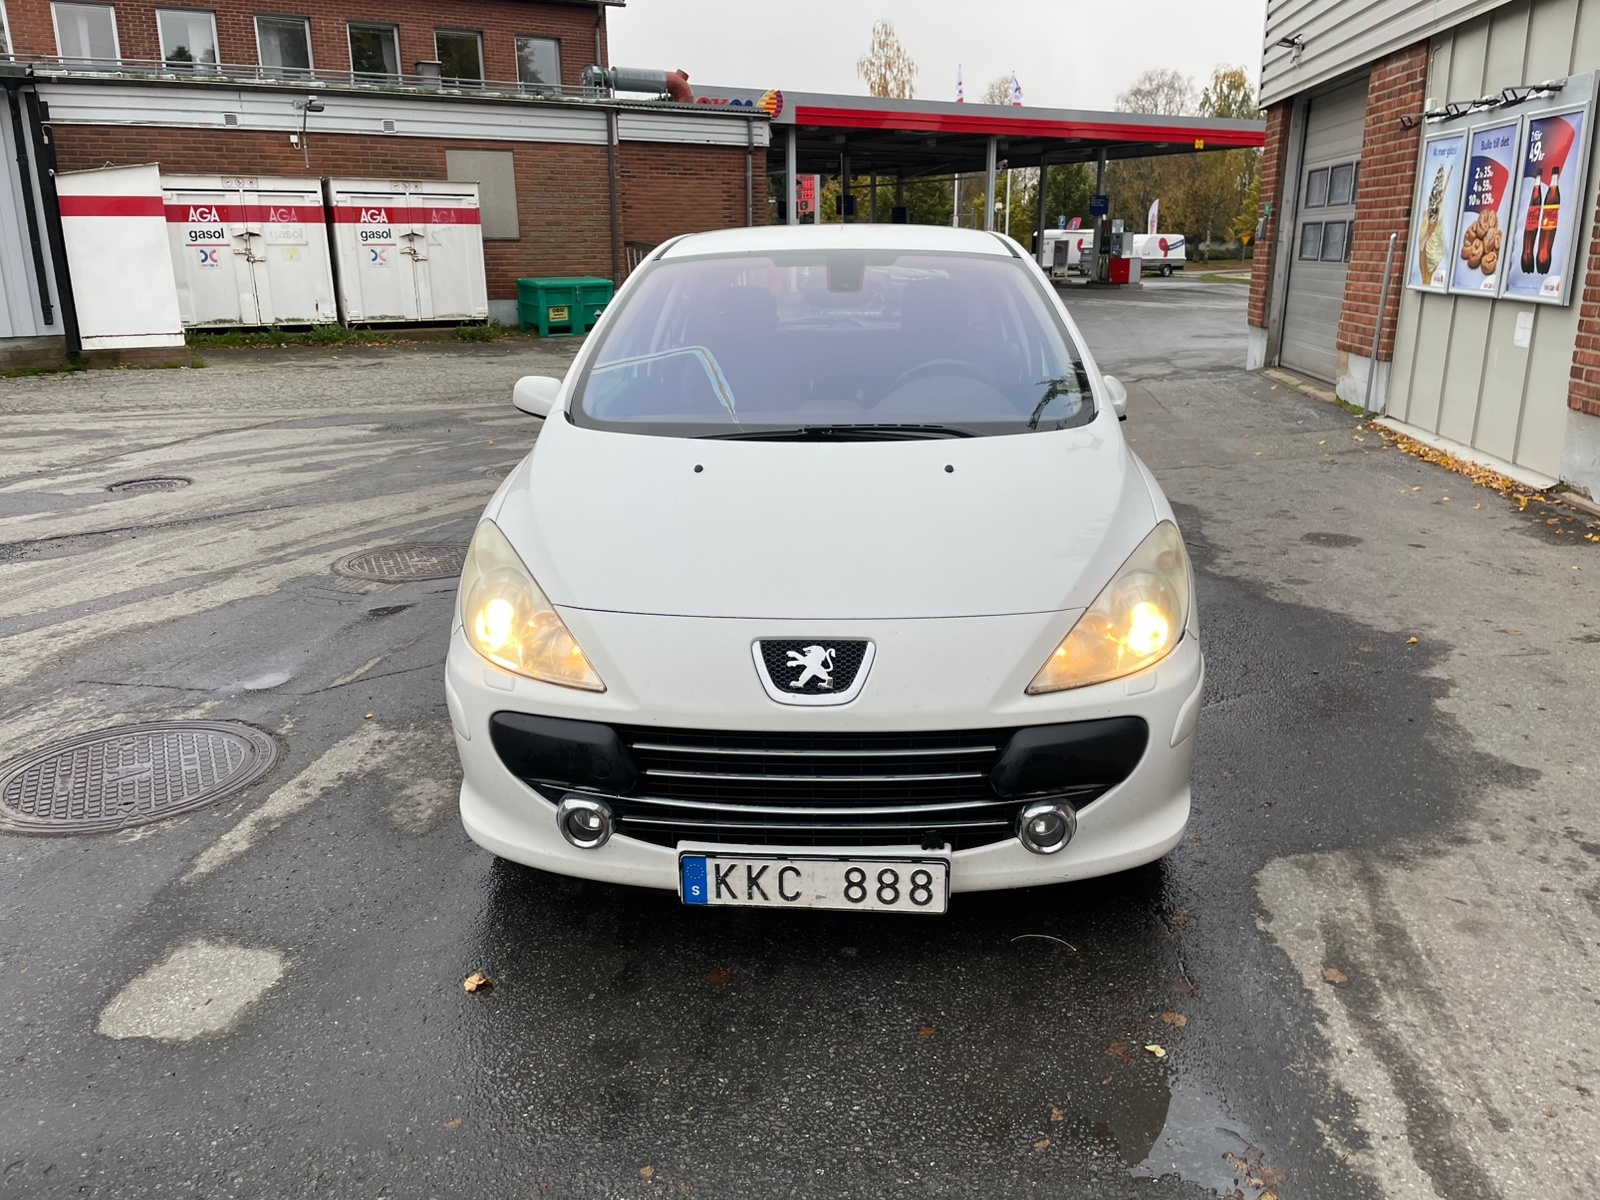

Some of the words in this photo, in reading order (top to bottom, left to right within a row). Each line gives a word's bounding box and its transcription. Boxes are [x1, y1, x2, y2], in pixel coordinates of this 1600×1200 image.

[1500, 136, 1509, 147] det
[1475, 167, 1480, 179] 2
[1468, 194, 1476, 206] 10
[188, 206, 220, 222] AGA
[269, 206, 297, 222] AGA
[360, 208, 388, 223] AGA
[431, 209, 456, 223] AGA
[189, 228, 224, 242] gasol
[270, 228, 303, 240] gasol
[360, 228, 391, 241] gasol
[691, 886, 700, 896] S
[714, 863, 802, 901] KKC
[844, 867, 933, 906] 888
